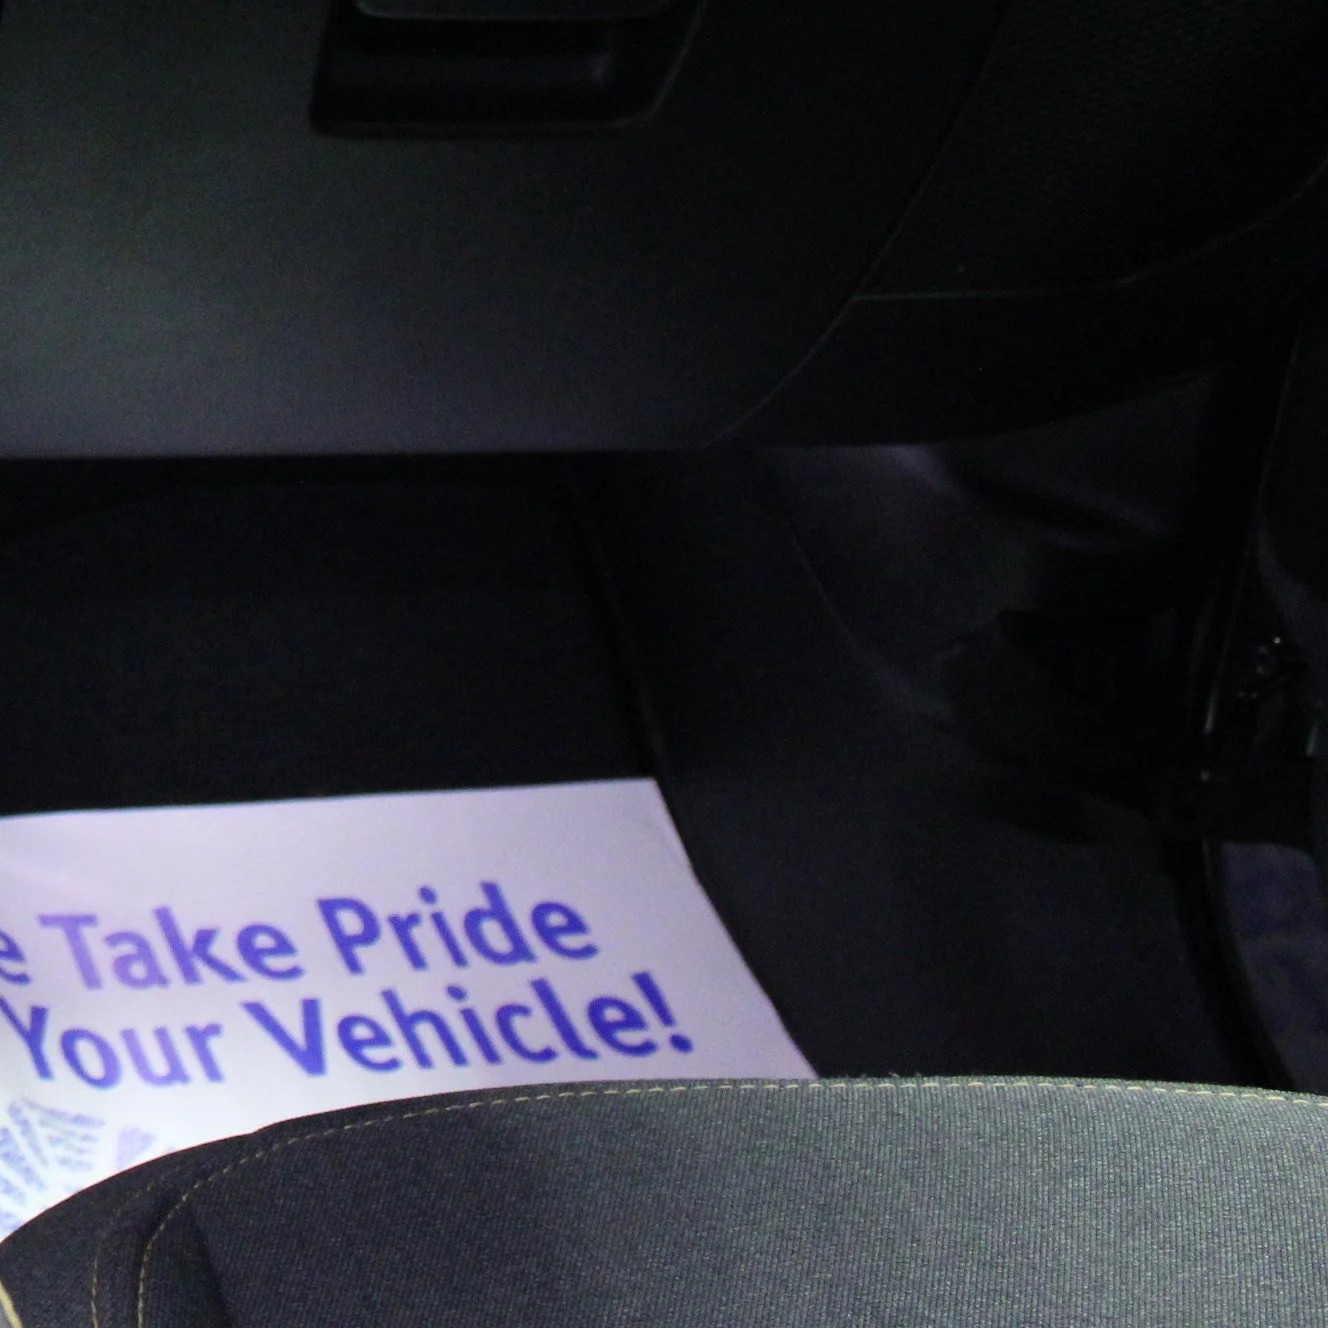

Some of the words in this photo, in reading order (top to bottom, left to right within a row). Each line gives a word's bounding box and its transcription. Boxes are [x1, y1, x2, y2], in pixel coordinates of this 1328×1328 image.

[38, 905, 305, 991] Take
[315, 881, 601, 976] Pride
[241, 969, 696, 1077] Vehicle!
